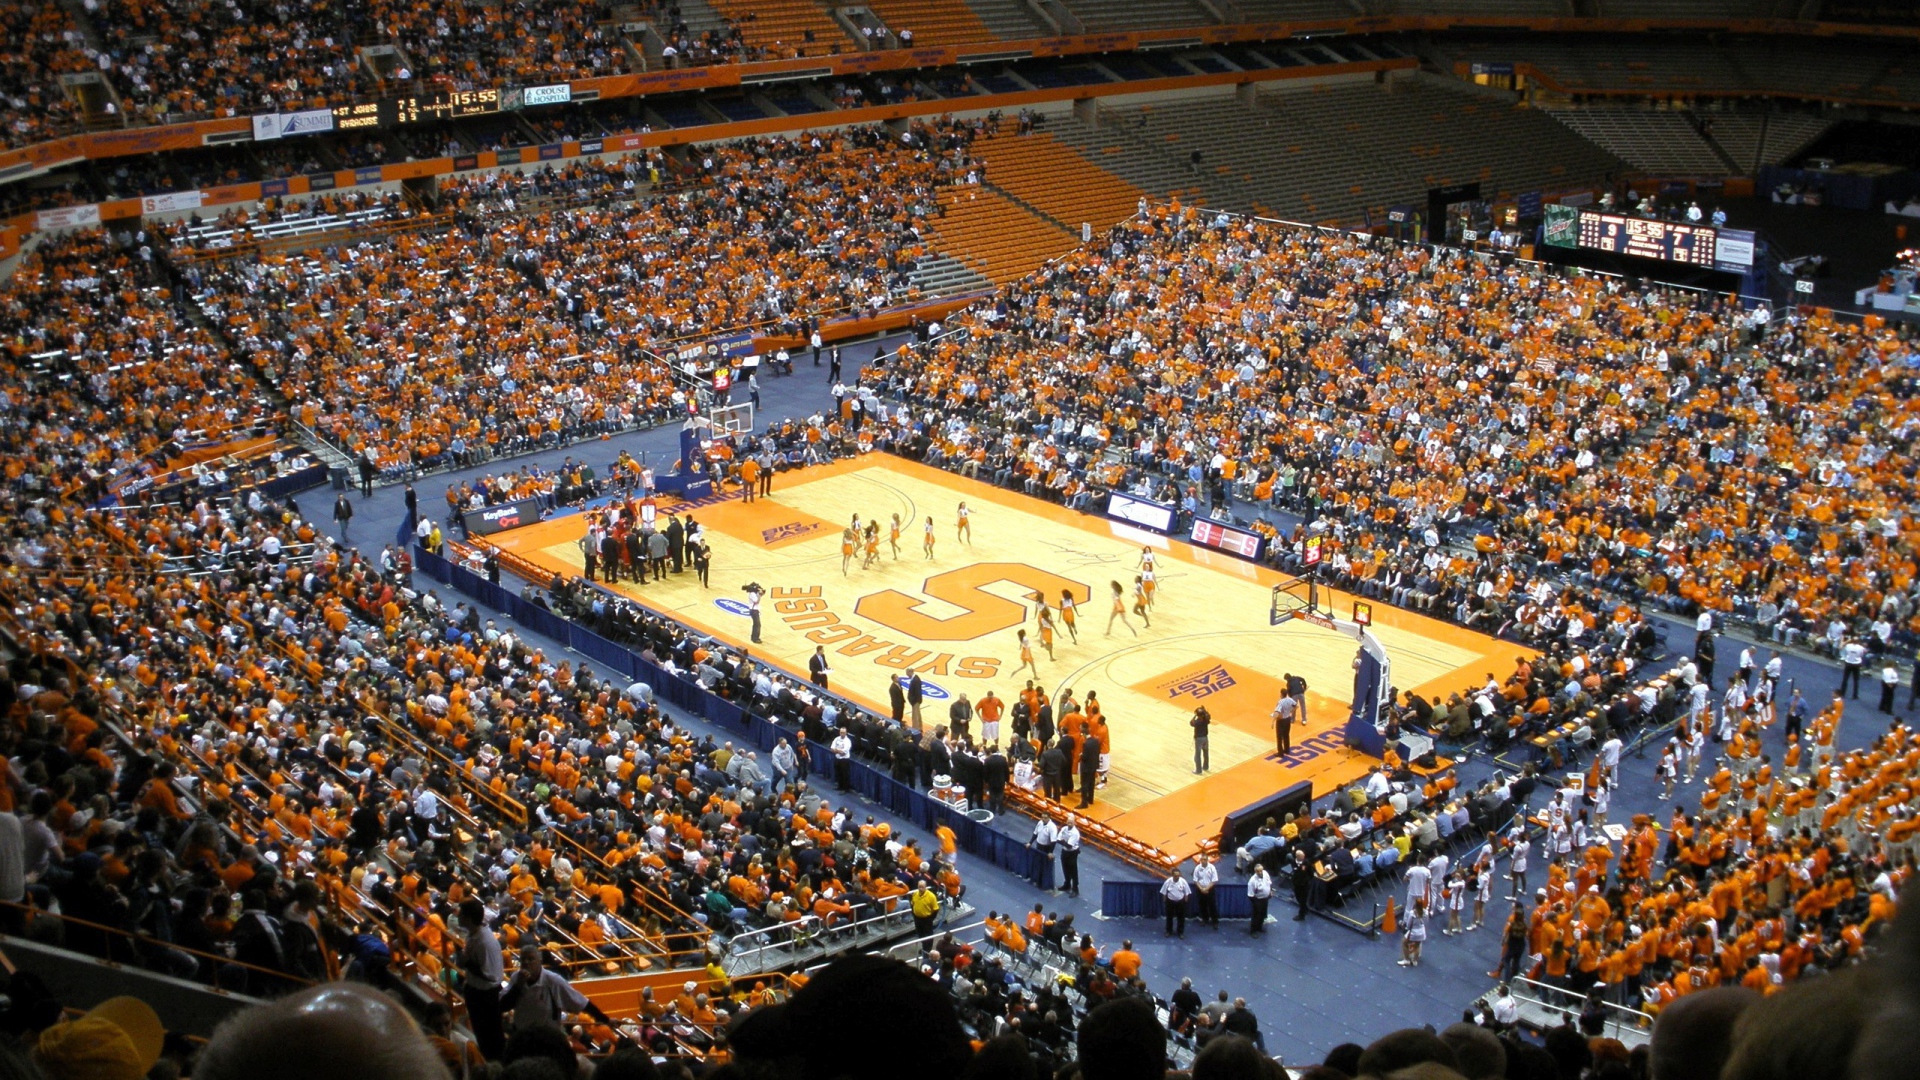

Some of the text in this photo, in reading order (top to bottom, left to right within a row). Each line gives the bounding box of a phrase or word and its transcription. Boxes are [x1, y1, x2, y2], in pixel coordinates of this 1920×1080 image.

[535, 86, 566, 96] CROUSE
[454, 90, 497, 106] 15:55
[533, 94, 569, 103] HOSPITAL
[338, 104, 378, 116] ST JOHNS
[398, 100, 405, 110] 7
[294, 115, 332, 128] SUMMIT
[339, 116, 378, 128] SYRACUSE
[1464, 231, 1476, 240] 123
[1608, 224, 1616, 237] 9
[1629, 220, 1662, 238] 15:55
[1673, 233, 1682, 245] 7
[1797, 282, 1812, 292] 124
[716, 377, 728, 387] 35
[120, 473, 154, 497] KeyBank
[483, 506, 518, 521] KeyBank
[761, 521, 802, 537] BIG
[764, 522, 820, 543] EAST
[1306, 546, 1320, 562] 35
[770, 585, 1002, 679] SYRACUSE
[1168, 668, 1230, 699] EAST
[1191, 675, 1237, 700] BIG
[1017, 769, 1026, 778] 21
[1555, 808, 1563, 818] S
